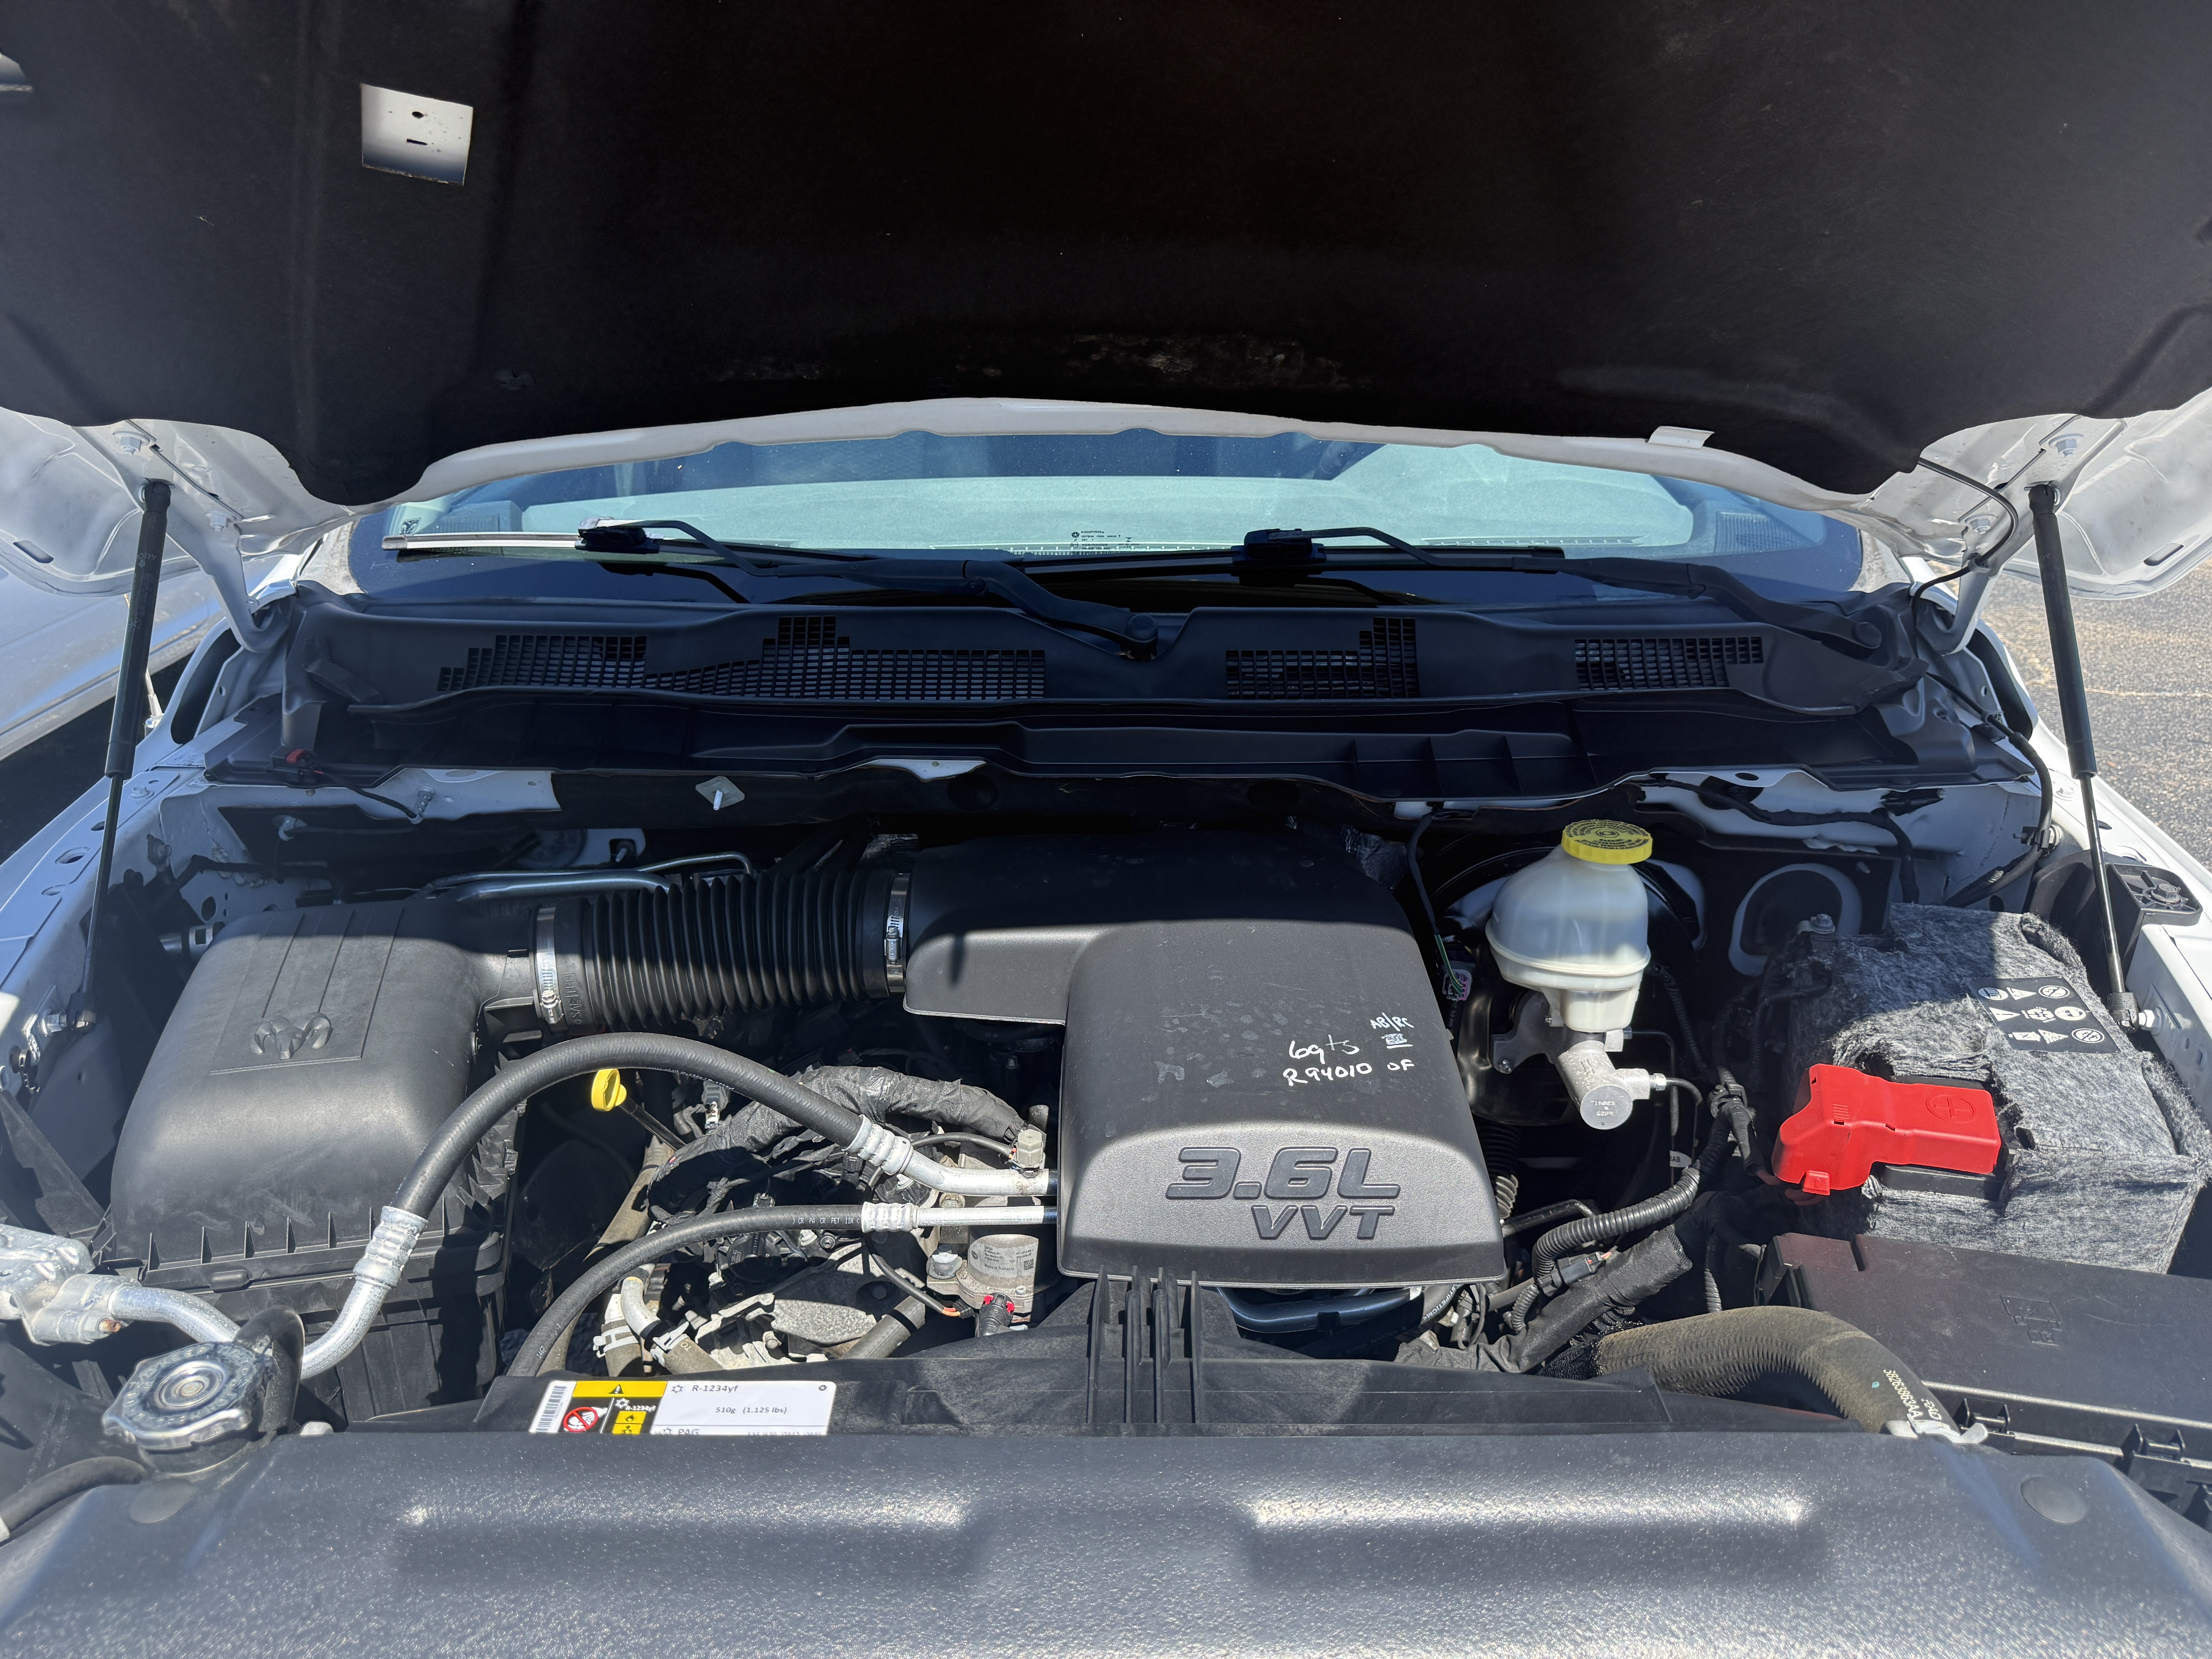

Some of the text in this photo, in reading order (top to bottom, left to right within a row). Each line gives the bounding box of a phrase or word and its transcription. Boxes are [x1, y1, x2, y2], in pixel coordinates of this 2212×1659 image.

[1165, 1146, 1401, 1200] 3.6L
[1250, 1205, 1395, 1240] VVT
[692, 1384, 738, 1393] R-1234yf
